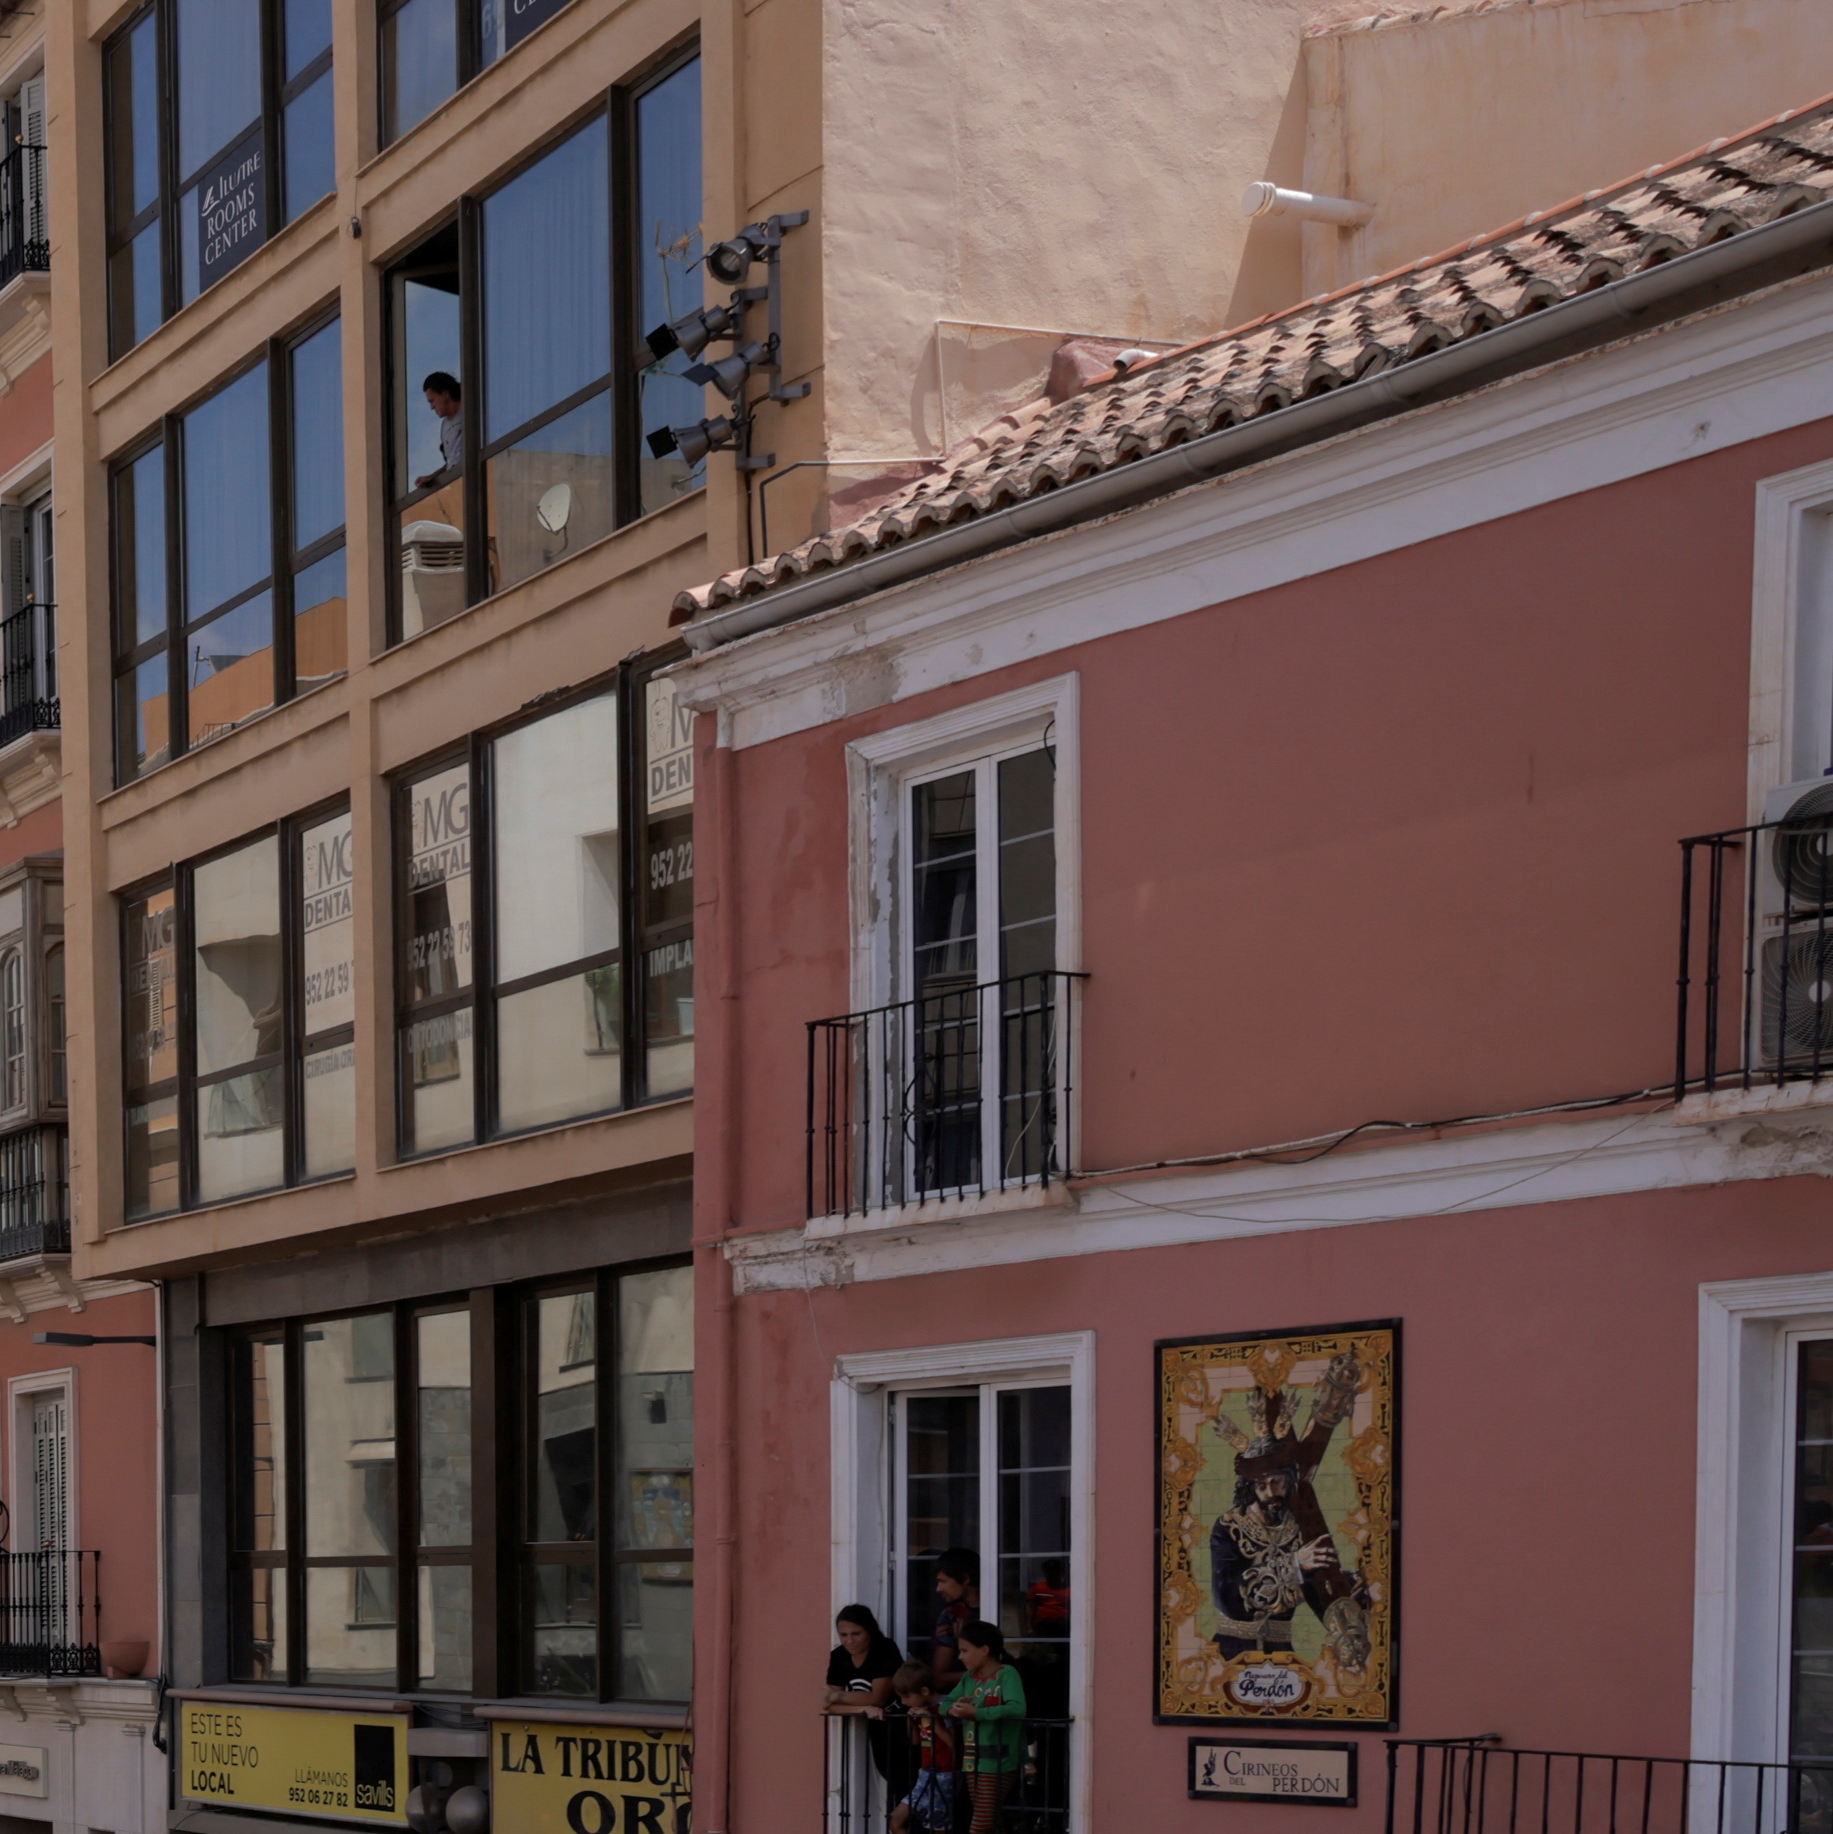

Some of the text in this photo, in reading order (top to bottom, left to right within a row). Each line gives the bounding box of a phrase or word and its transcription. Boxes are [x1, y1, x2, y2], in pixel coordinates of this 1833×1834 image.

[219, 151, 261, 200] ILUSTRE
[207, 182, 255, 239] ROOMS
[205, 208, 258, 265] CENTER
[651, 756, 694, 797] DEN
[423, 782, 469, 848] MG
[409, 843, 471, 888] DENTAL
[651, 848, 674, 890] 952
[306, 967, 349, 1006] 952 22 59
[1239, 1679, 1295, 1698] Perdón
[191, 1713, 242, 1737] ESTE ES
[191, 1741, 259, 1767] TU NUEVO
[500, 1733, 545, 1774] LA
[1224, 1750, 1299, 1777] CIRINEOS
[191, 1769, 235, 1795] LOCAL
[294, 1766, 349, 1788] LLÁMANOS
[1229, 1777, 1246, 1786] DEL
[1272, 1773, 1340, 1793] PERDÓN
[289, 1787, 349, 1808] 952 06 27 82
[356, 1780, 394, 1808] savills
